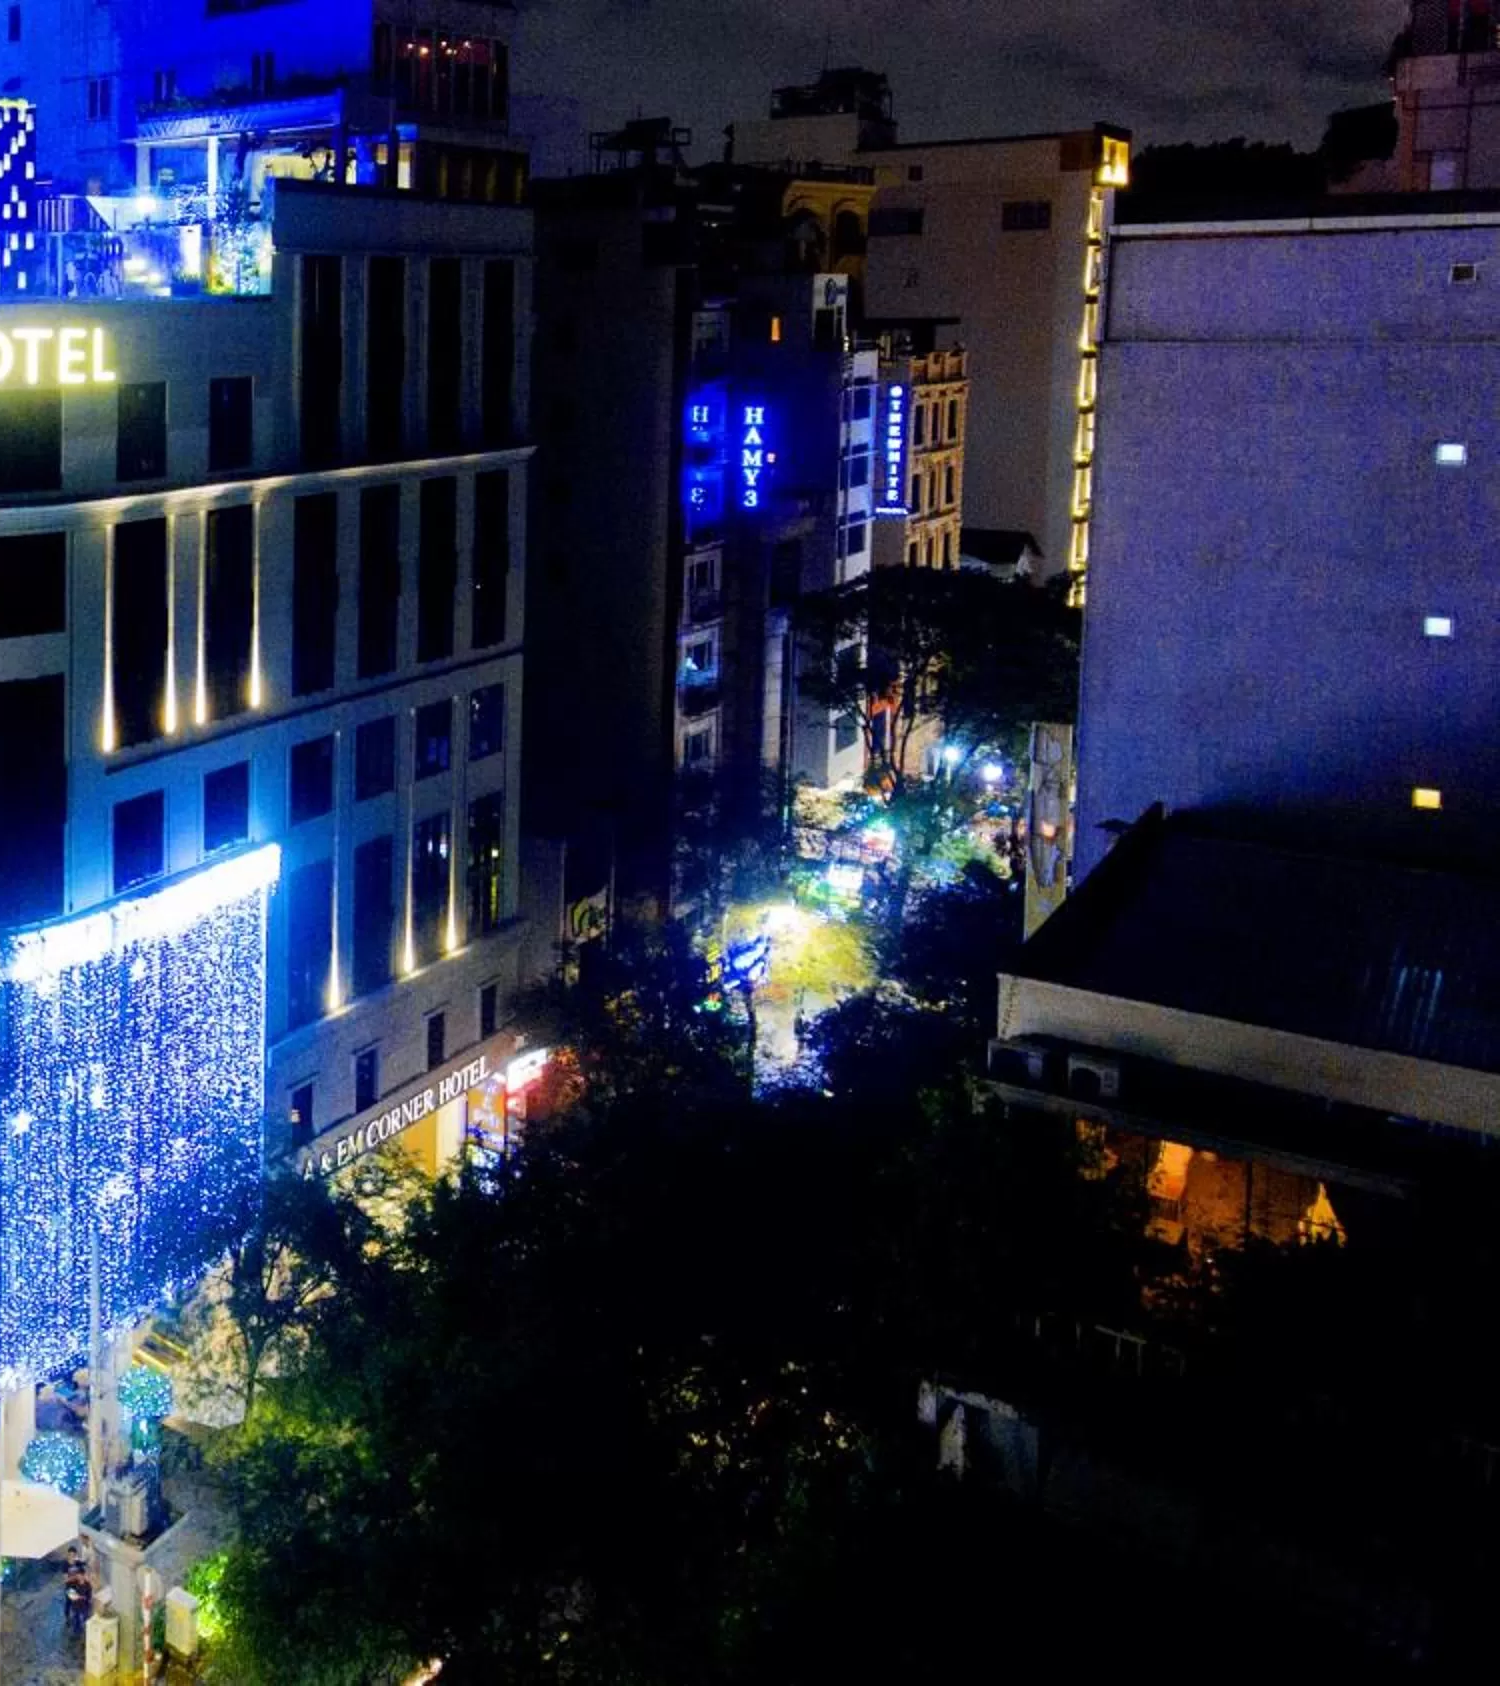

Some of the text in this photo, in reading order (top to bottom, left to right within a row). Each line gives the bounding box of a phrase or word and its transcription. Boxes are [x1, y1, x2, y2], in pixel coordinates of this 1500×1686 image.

[336, 1129, 365, 1167] EM
[366, 1089, 436, 1148] CORNER
[438, 1056, 491, 1105] HOTEL
